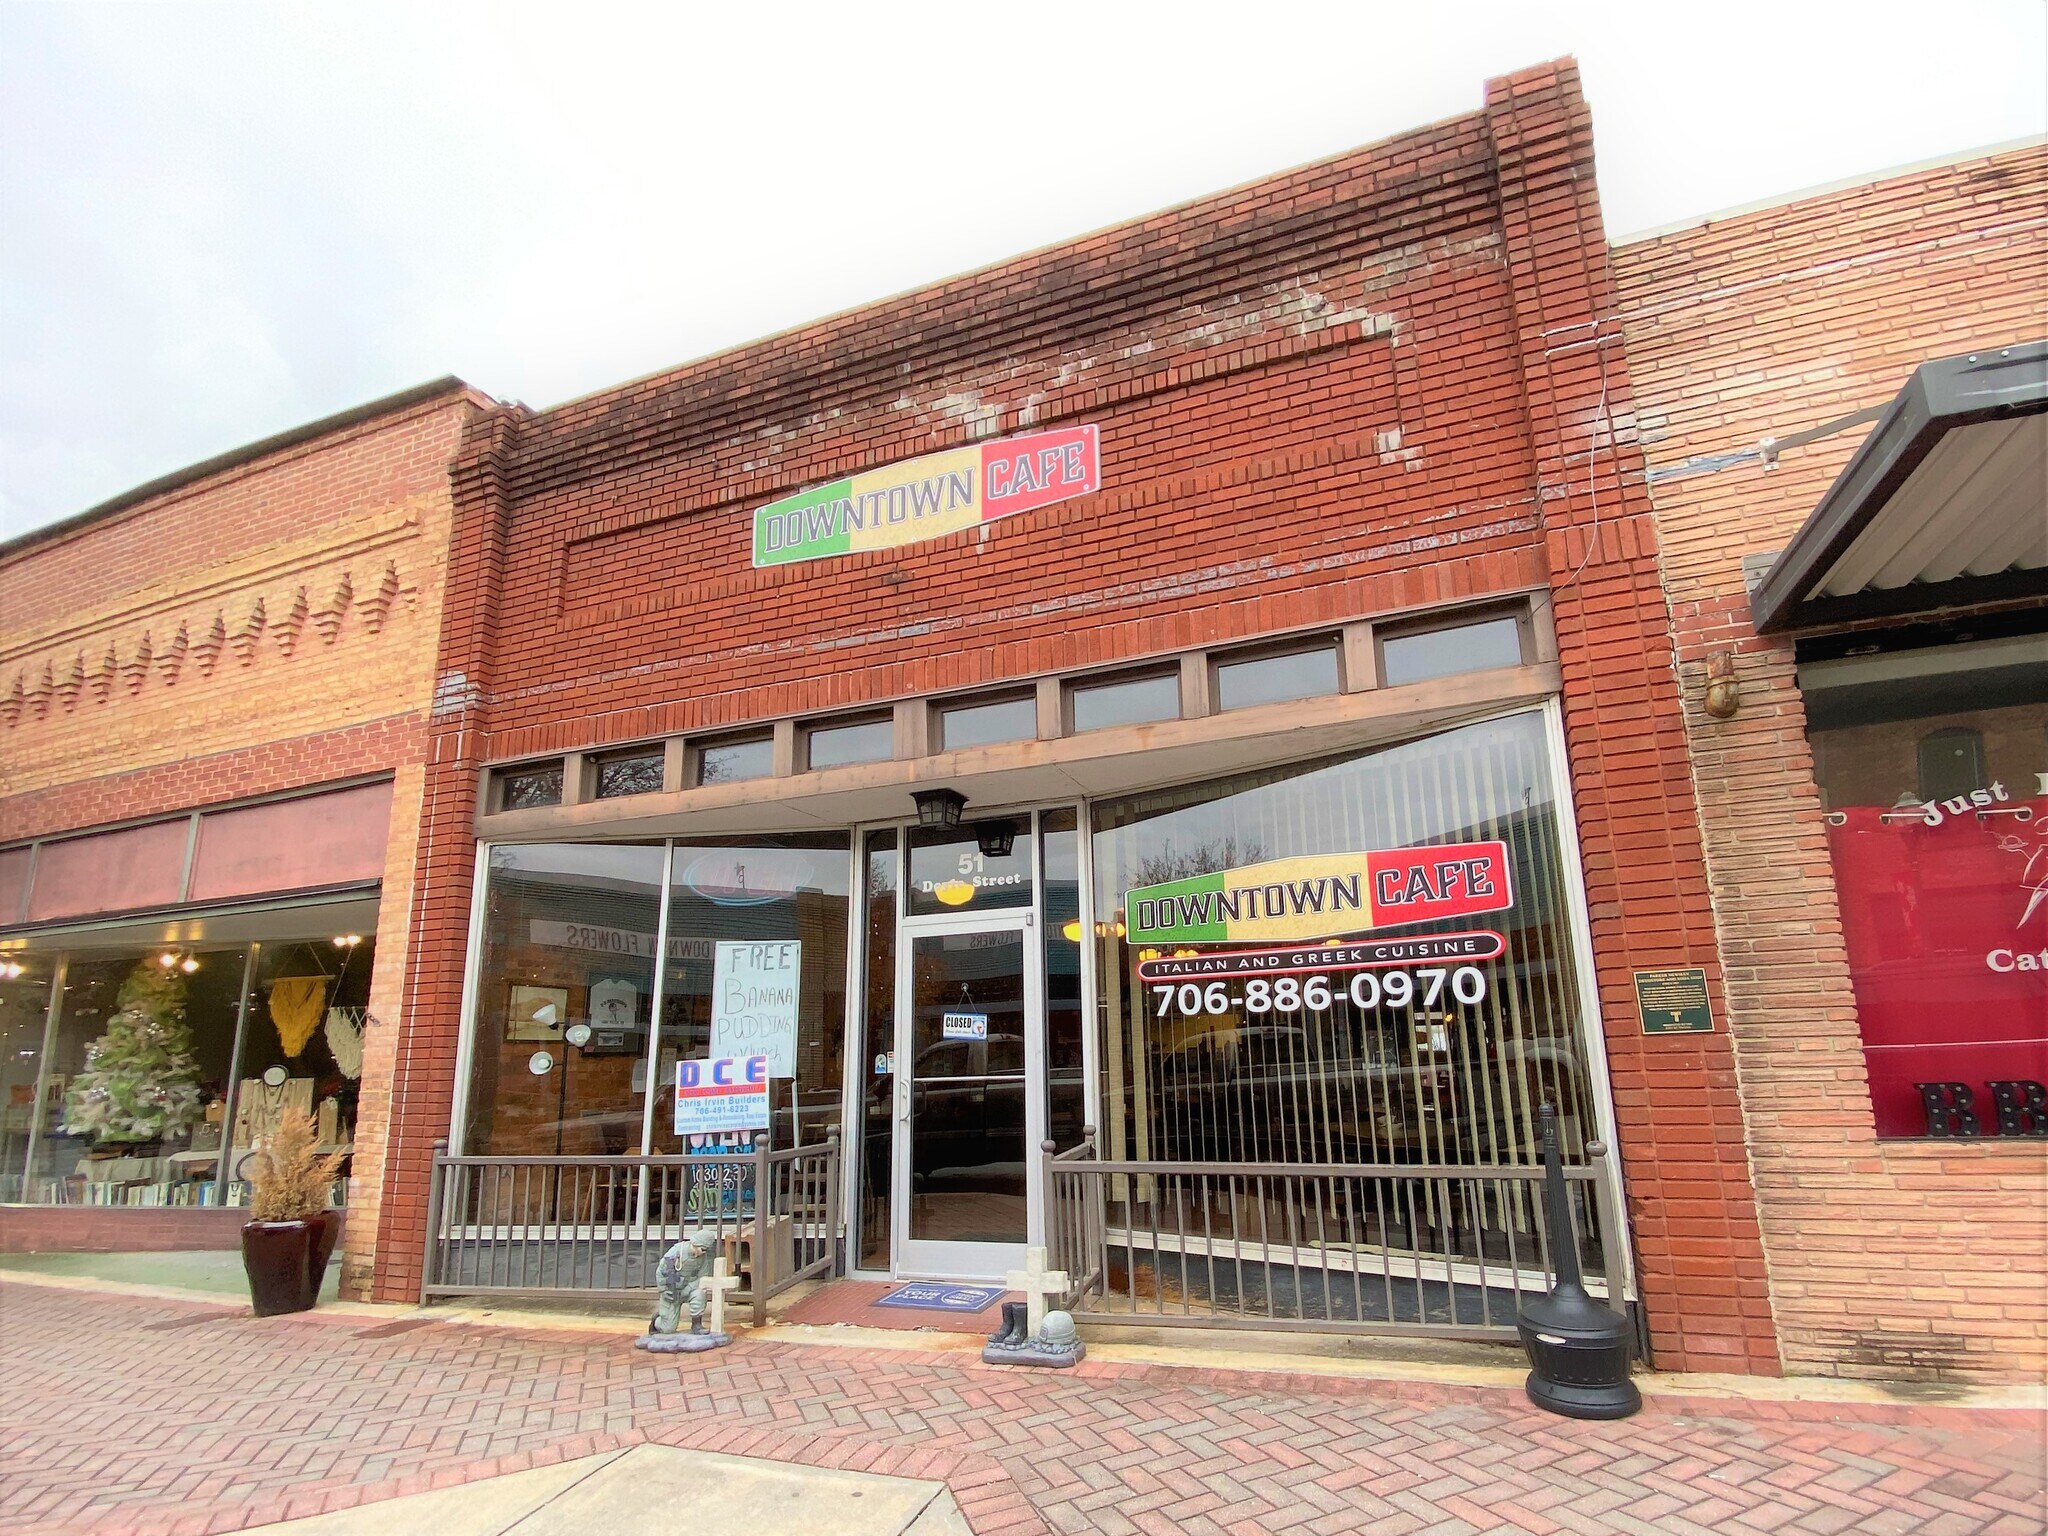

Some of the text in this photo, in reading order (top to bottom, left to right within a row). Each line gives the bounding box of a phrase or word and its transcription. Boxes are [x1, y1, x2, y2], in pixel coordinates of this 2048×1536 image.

[764, 441, 1085, 554] DOWNTOWN CAFE
[1923, 780, 2009, 827] Just
[958, 852, 984, 875] 51
[972, 873, 1021, 888] Street
[1136, 857, 1494, 932] DOWNTOWN CAFE
[731, 943, 792, 973] FREE
[1154, 939, 1477, 975] ITALIAN AND GREEK CUISINE
[725, 978, 793, 1015] BANANA
[1152, 965, 1486, 1017] 706-886-0970
[717, 1013, 793, 1045] PUDDING
[945, 1016, 972, 1029] CLOSED
[677, 1095, 766, 1108] Chris Irvin Builders
